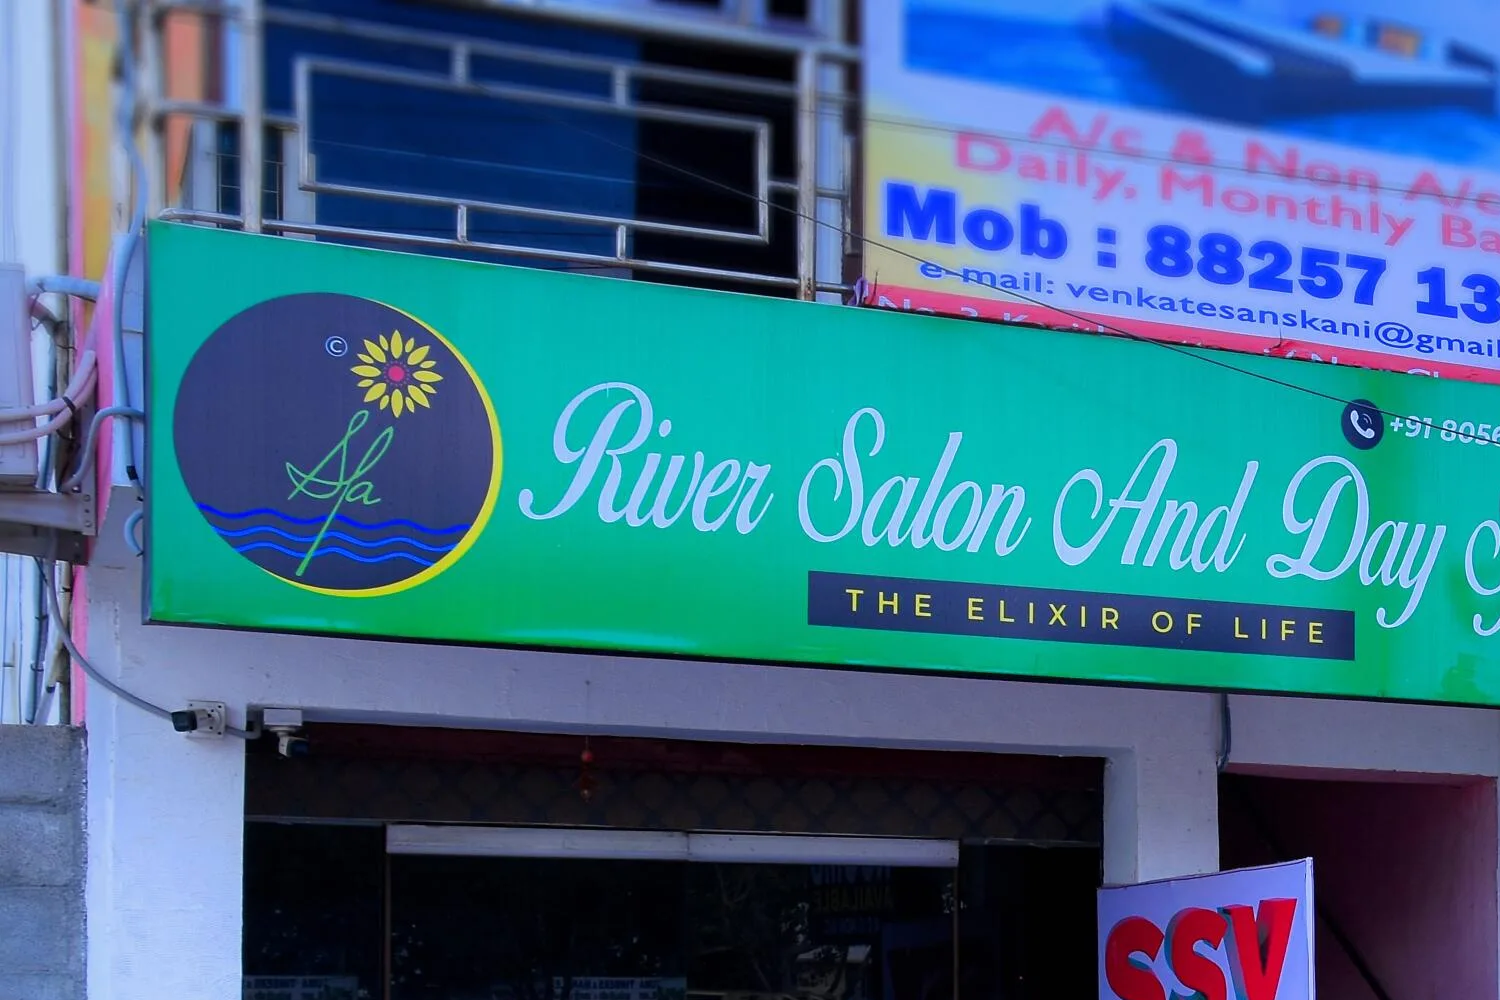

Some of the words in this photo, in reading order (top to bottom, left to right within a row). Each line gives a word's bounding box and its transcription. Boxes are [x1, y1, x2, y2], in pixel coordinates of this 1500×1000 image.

[956, 131, 1137, 200] Daily,
[1160, 166, 1415, 246] Monthly
[1245, 139, 1380, 194] Non
[886, 183, 1068, 260] Mob
[1145, 224, 1386, 306] 88257
[919, 261, 1054, 295] e-mail:
[1390, 415, 1433, 439] +91
[518, 381, 774, 535] River
[798, 407, 1032, 556] Salon
[1053, 438, 1259, 572] And
[1266, 455, 1447, 628] Day
[845, 588, 932, 617] THE
[968, 598, 1119, 629] ELIXIR
[1151, 611, 1203, 635] OF
[1234, 617, 1324, 643] LIFE
